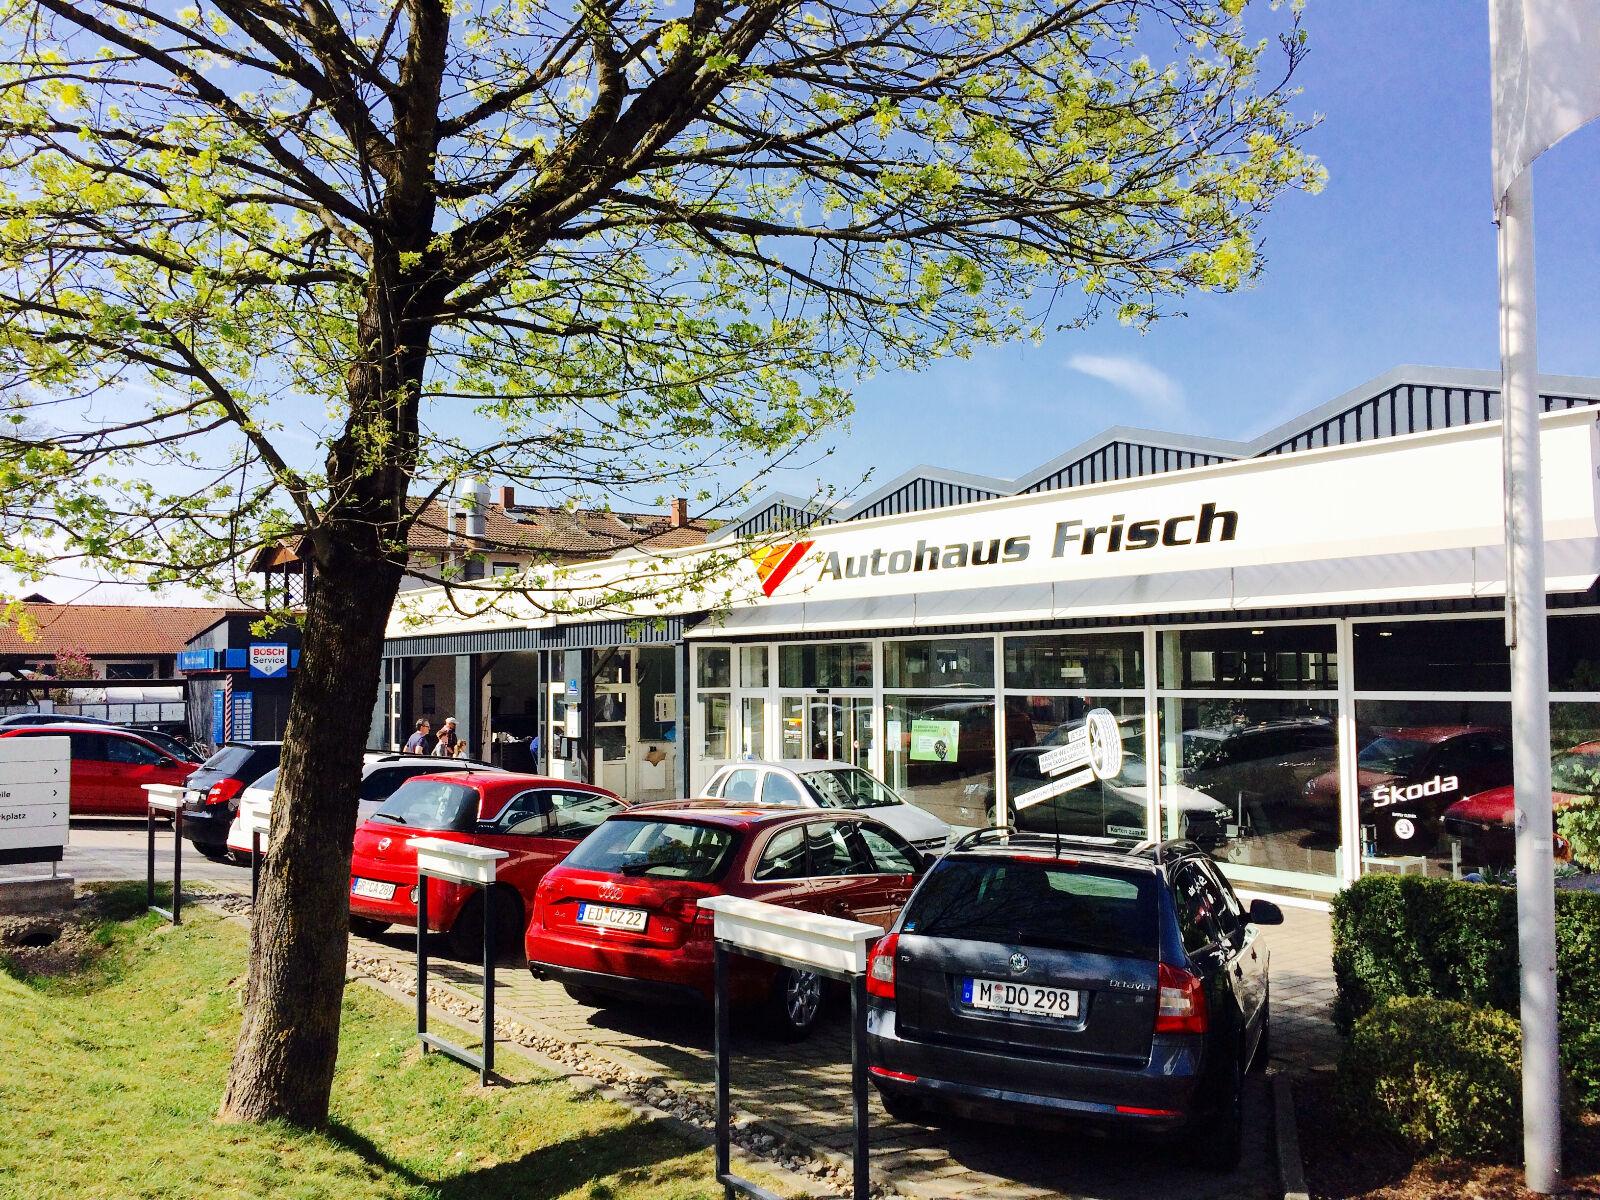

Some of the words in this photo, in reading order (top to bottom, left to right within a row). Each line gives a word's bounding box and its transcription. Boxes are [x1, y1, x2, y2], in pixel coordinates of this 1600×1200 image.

[817, 534, 1031, 582] Autohaus
[1051, 502, 1239, 558] Frisch
[253, 656, 285, 664] Service
[0, 813, 26, 821] kplatz
[587, 907, 603, 921] ED
[609, 910, 626, 924] CZ
[626, 911, 642, 926] 22
[980, 982, 992, 1001] M
[1005, 985, 1029, 1007] DO
[1034, 989, 1070, 1011] 298
